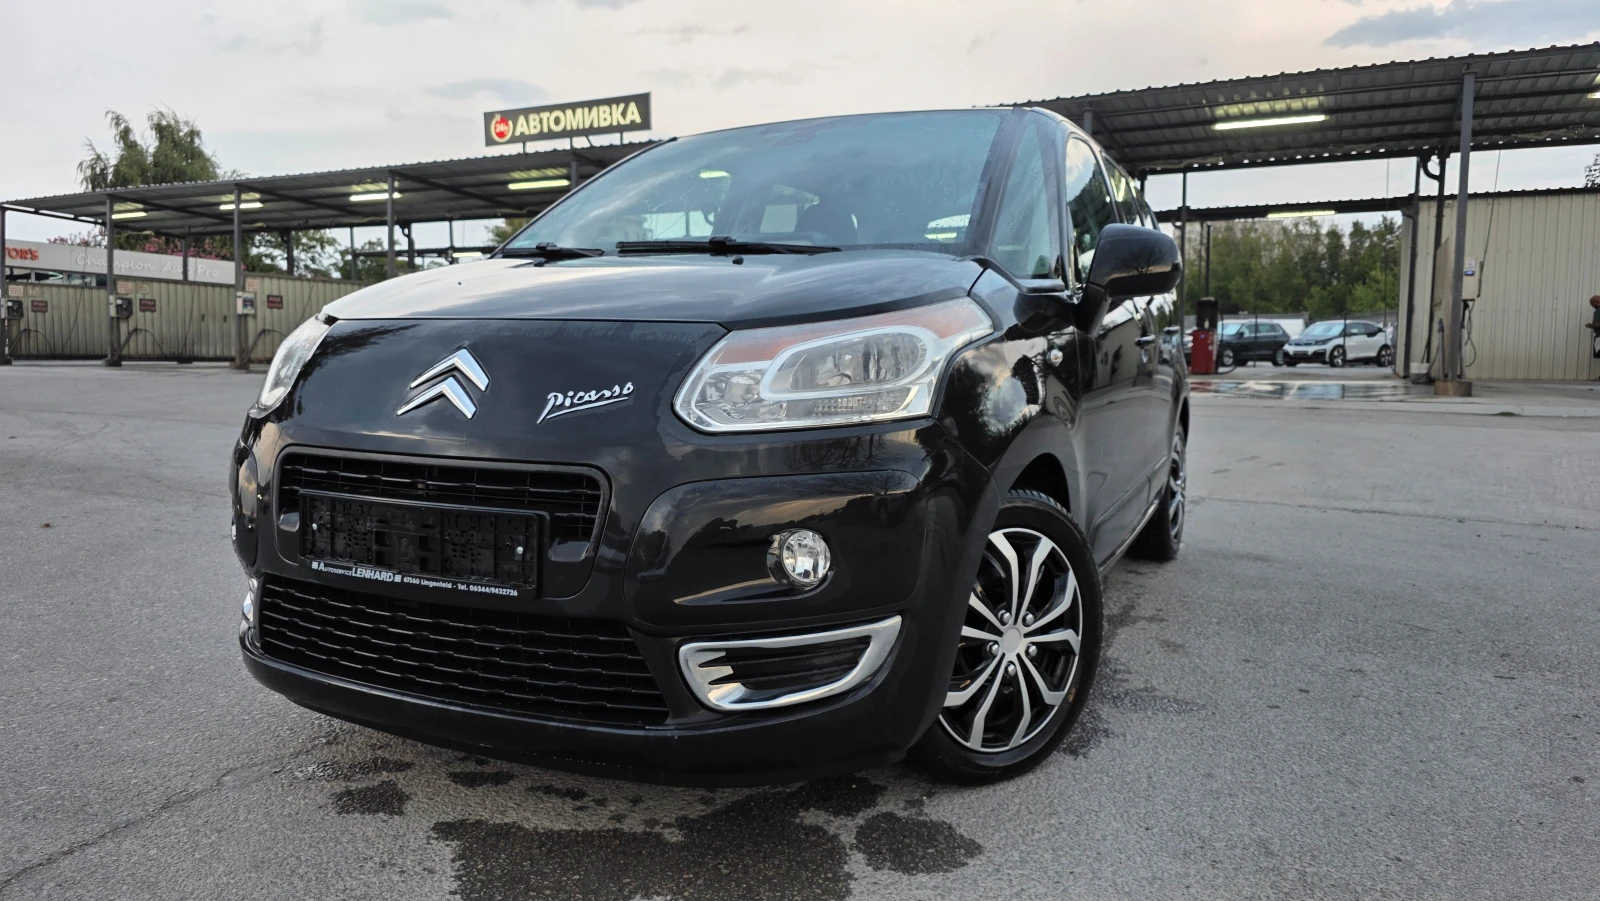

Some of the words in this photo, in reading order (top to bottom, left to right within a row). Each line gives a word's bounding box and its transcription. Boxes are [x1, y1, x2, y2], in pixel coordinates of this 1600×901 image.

[514, 101, 642, 137] АВТОМИВКА
[197, 264, 218, 277] Pro
[352, 567, 394, 582] LENHARD
[421, 579, 451, 589] Lingenfeld
[457, 583, 468, 591] Tel.
